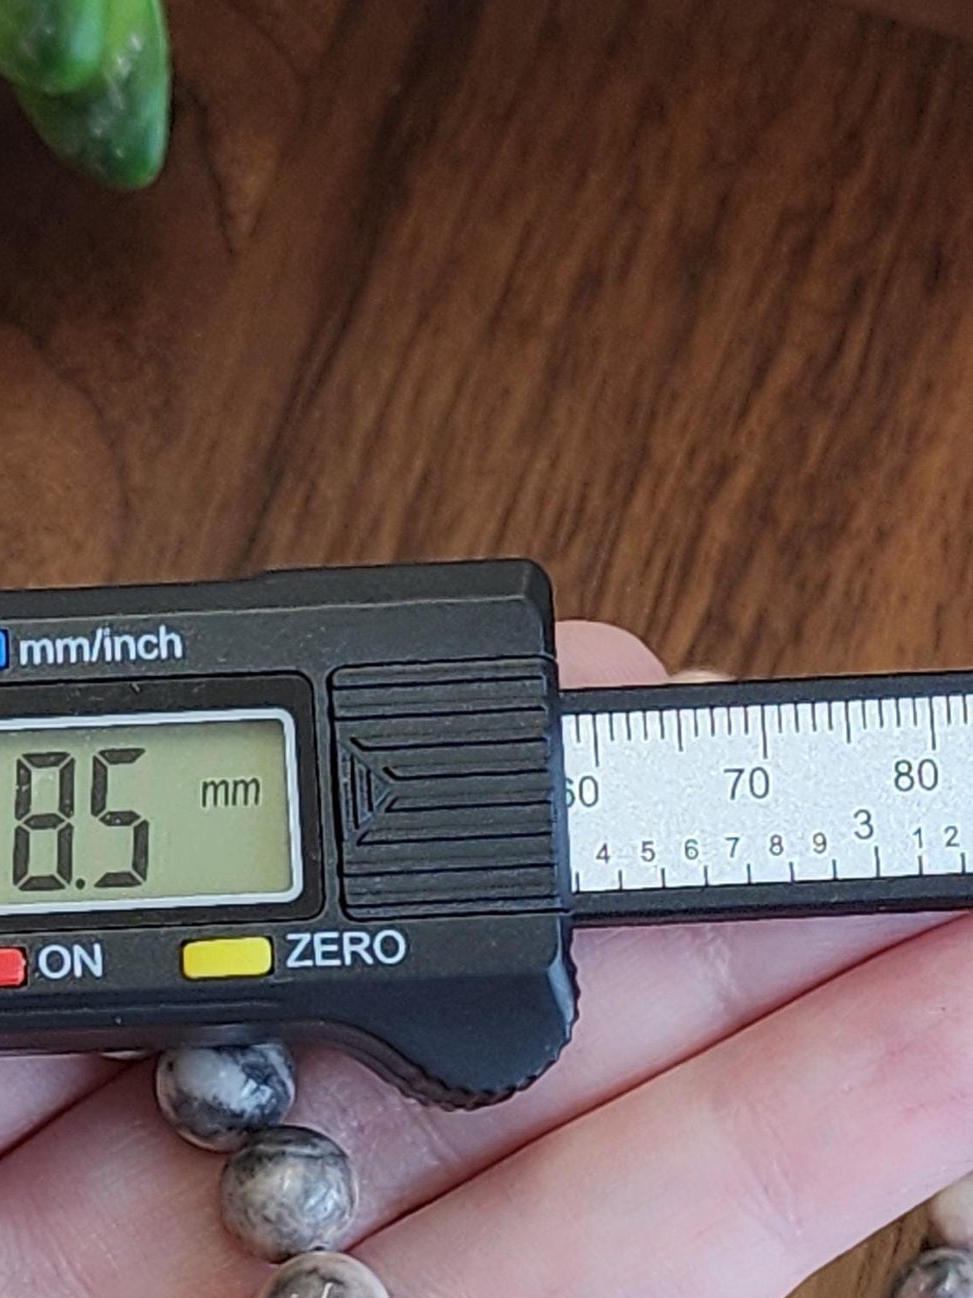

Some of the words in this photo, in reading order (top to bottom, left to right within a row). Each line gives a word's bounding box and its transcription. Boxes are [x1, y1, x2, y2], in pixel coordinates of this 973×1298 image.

[19, 625, 182, 665] mm/inch
[724, 767, 770, 800] 70
[893, 758, 939, 792] 80
[12, 747, 150, 892] 8.5
[201, 776, 260, 808] mm
[853, 809, 875, 840] 3
[596, 842, 611, 864] 4
[640, 841, 656, 863] 5
[684, 838, 700, 860] 6
[726, 836, 741, 857] 7
[769, 834, 785, 856] 8
[812, 832, 828, 854] 9
[913, 827, 924, 848] 1
[944, 826, 959, 848] 2
[37, 943, 104, 979] ON
[285, 930, 407, 969] ZERO
